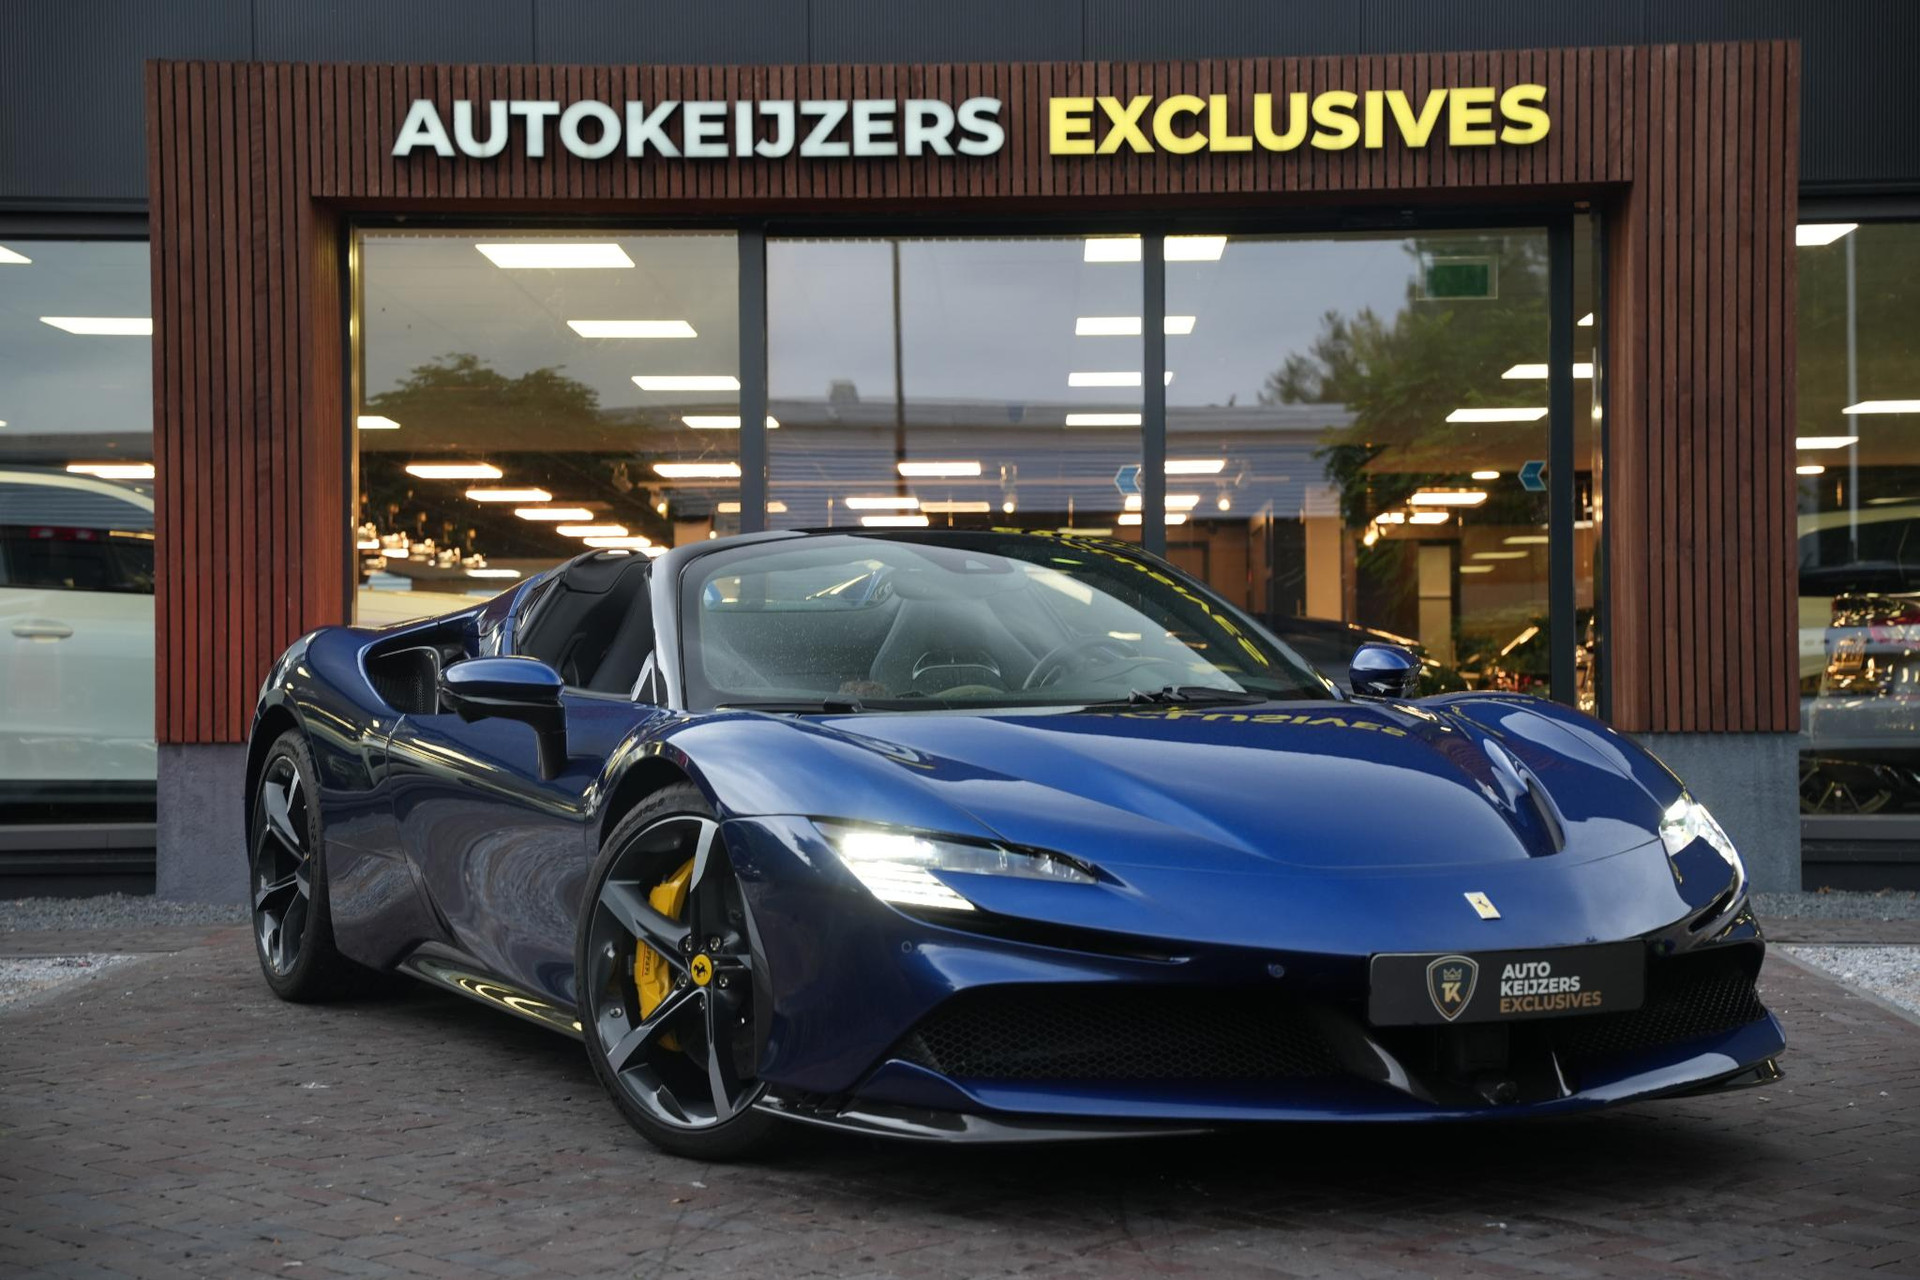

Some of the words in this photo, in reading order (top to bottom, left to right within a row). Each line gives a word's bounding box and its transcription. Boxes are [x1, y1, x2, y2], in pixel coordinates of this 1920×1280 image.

[391, 97, 1006, 159] AUTOKEIJZERS
[1048, 83, 1551, 155] EXCLUSIVES
[1501, 961, 1551, 980] AUTO
[1500, 975, 1581, 997] KEIJZERS
[1500, 990, 1602, 1013] EXCLUSIVES
